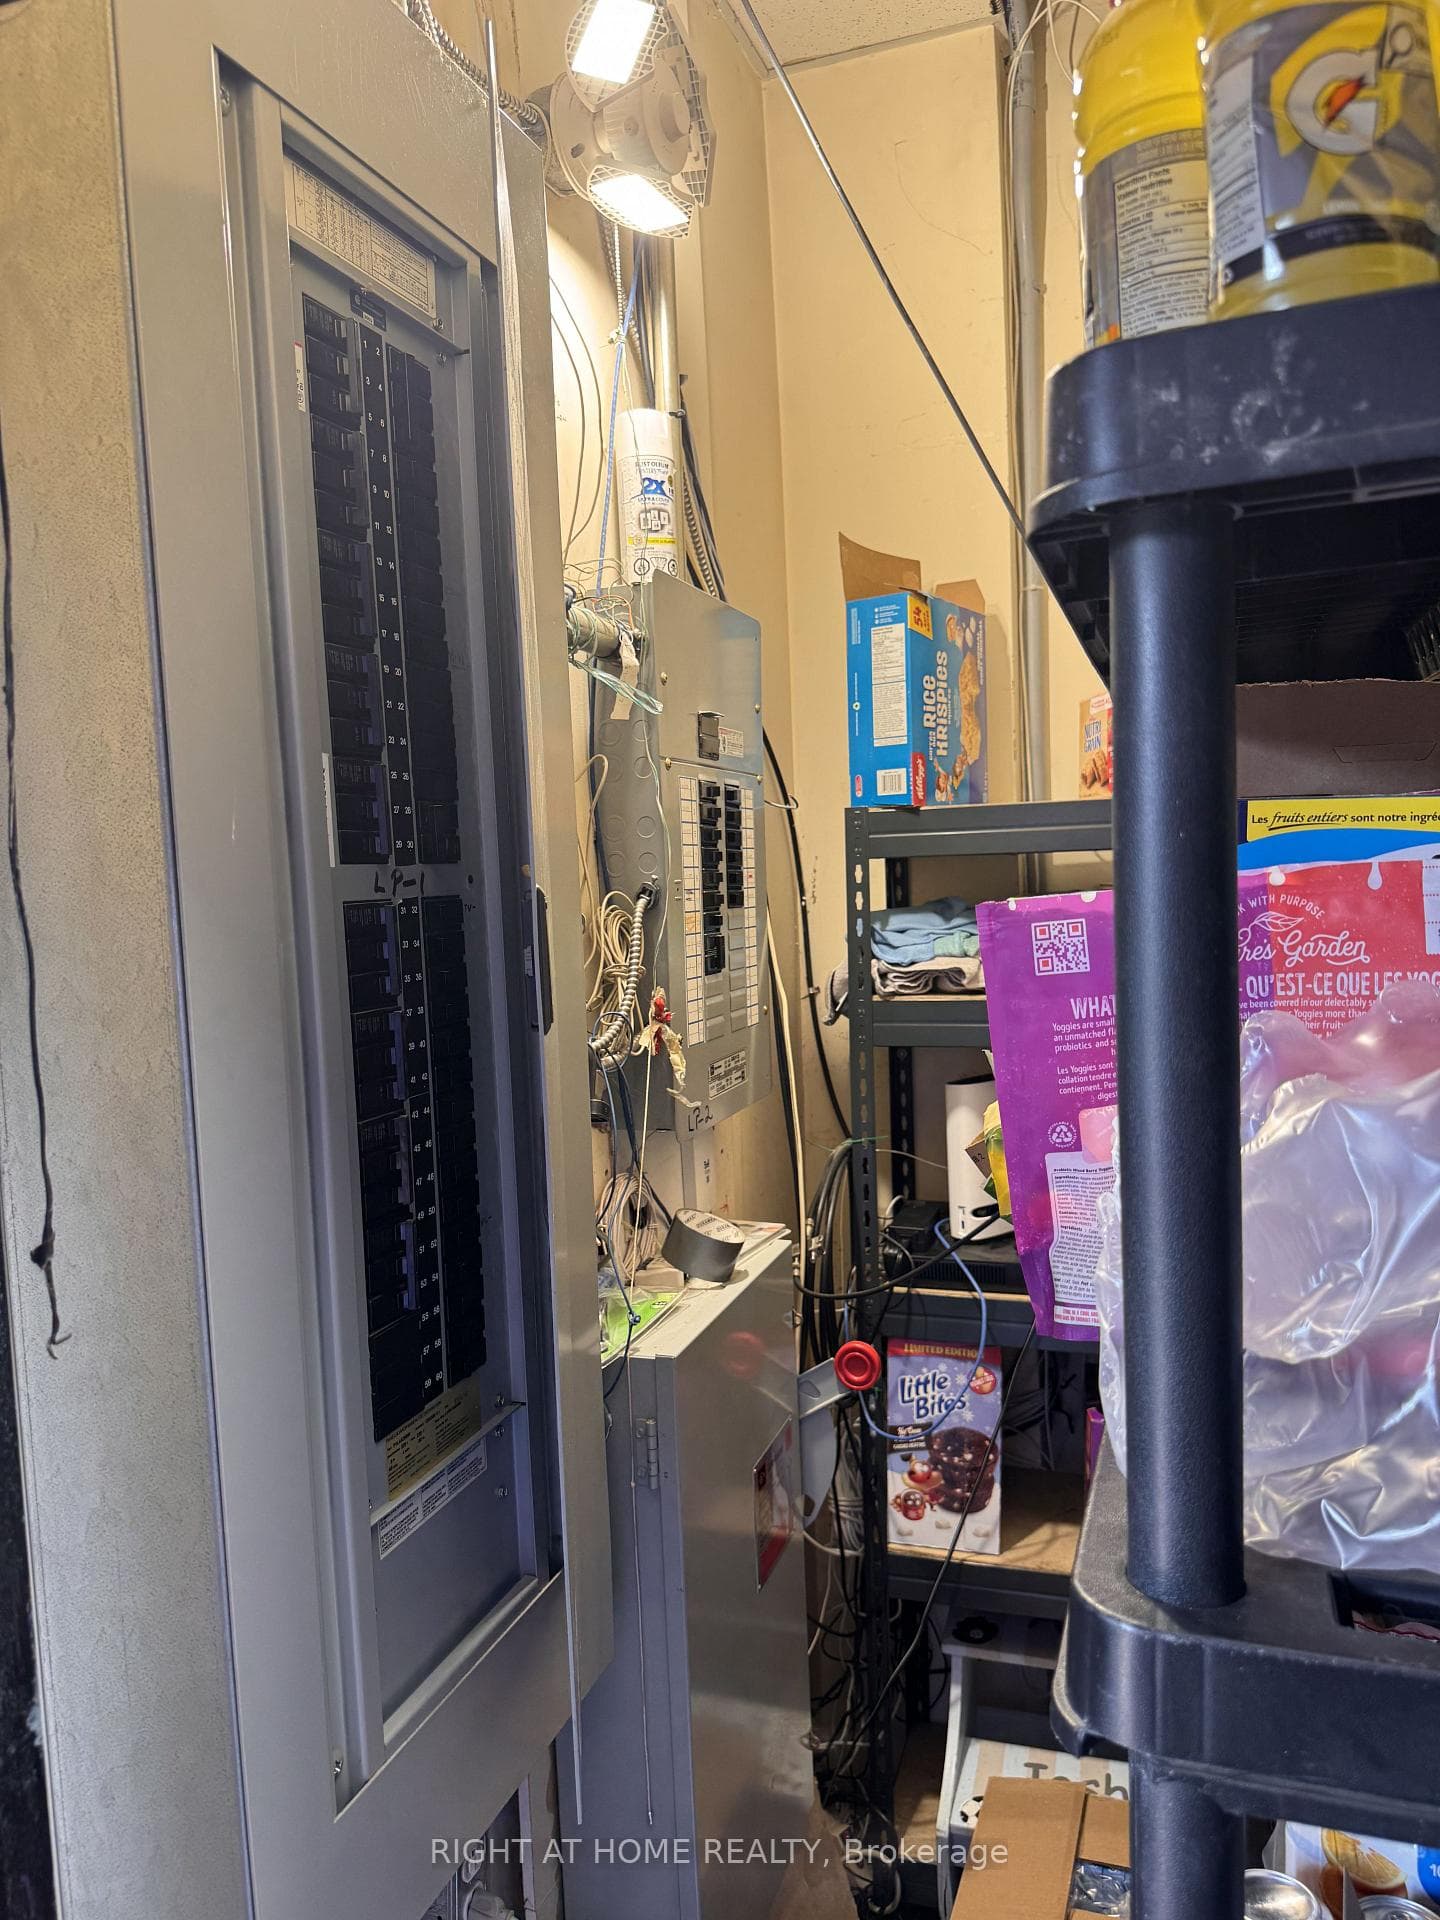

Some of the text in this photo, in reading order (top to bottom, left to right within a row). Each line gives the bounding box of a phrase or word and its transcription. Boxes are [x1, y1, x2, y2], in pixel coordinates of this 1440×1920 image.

[1252, 814, 1269, 824] Les
[1270, 812, 1306, 828] fruits
[1307, 812, 1349, 824] entiers
[1350, 814, 1375, 823] sont
[1378, 813, 1407, 823] notre
[1248, 894, 1275, 907] WITH
[1280, 894, 1326, 920] PURPOSE
[1277, 930, 1371, 968] Garden
[1246, 972, 1334, 999] QU'EST-CE
[1336, 972, 1370, 998] QUE
[1250, 998, 1269, 1008] been
[1270, 997, 1300, 1008] covered
[1300, 997, 1308, 1006] in
[1309, 998, 1323, 1006] our
[1324, 996, 1366, 1008] delectably
[1294, 1009, 1324, 1020] Yoggies
[1325, 1010, 1346, 1018] more
[1052, 1018, 1116, 1036] Yoggies are small
[1053, 1033, 1062, 1042] an
[1064, 1029, 1106, 1042] unmatched
[1055, 1043, 1092, 1054] probiotics
[1095, 1039, 1109, 1048] and
[1056, 1062, 1114, 1076] Les Yoggies sont
[1058, 1072, 1112, 1085] collation tendre
[904, 1343, 980, 1359] LIMITED EDITIO
[898, 1371, 950, 1404] Little
[913, 1393, 966, 1420] Bites
